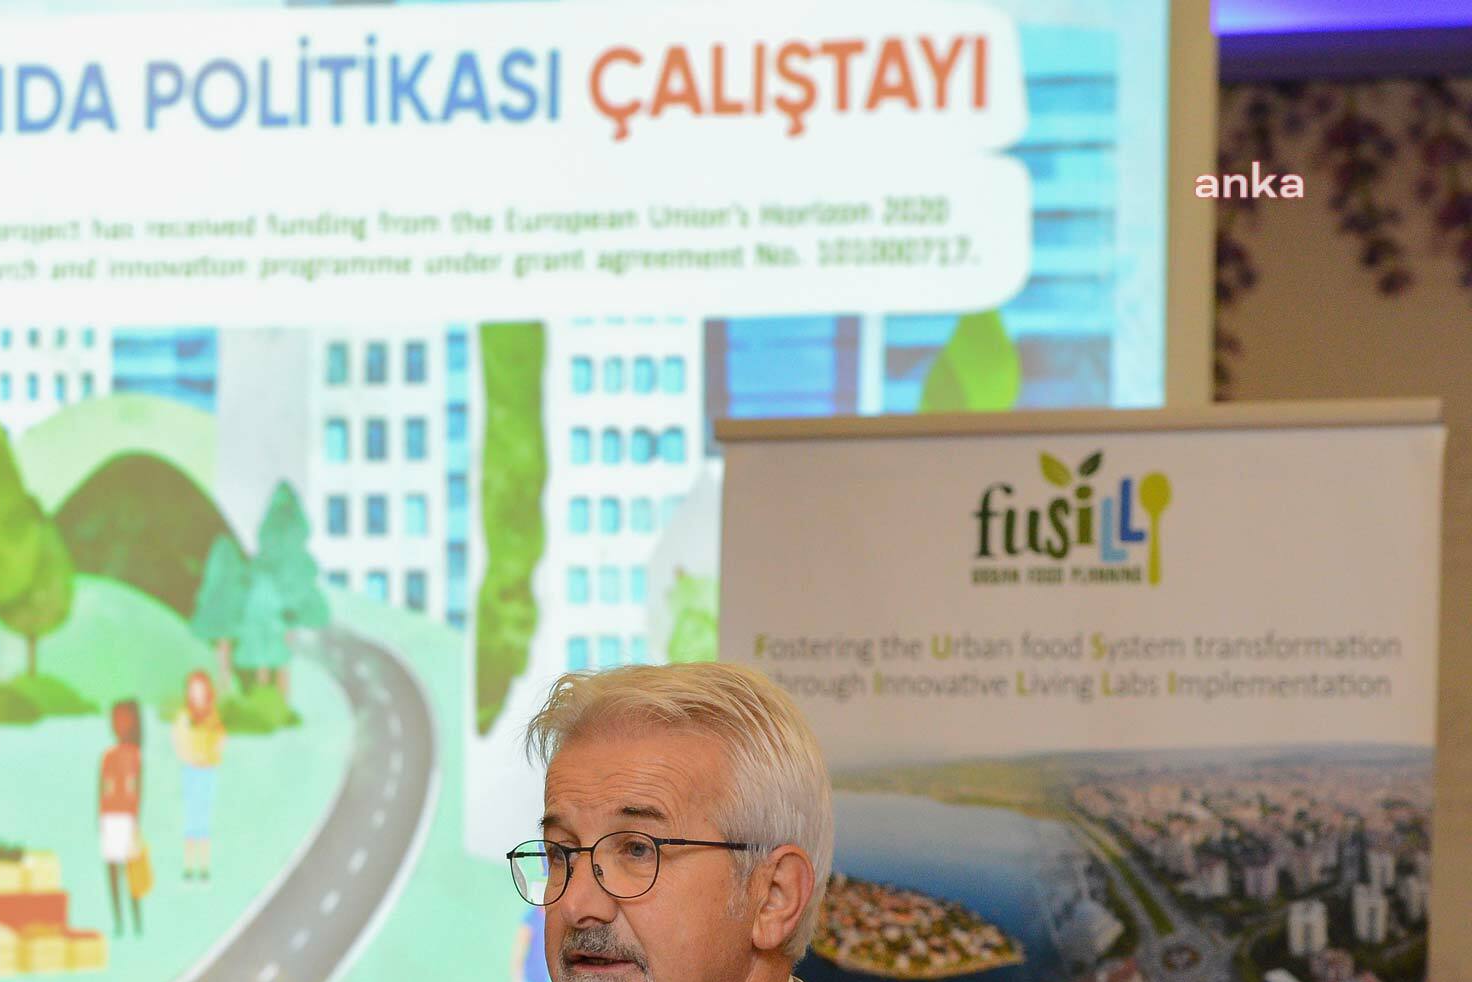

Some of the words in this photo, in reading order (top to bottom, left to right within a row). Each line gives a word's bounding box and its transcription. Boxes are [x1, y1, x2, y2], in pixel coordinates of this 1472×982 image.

[144, 34, 562, 132] POLİTİKASI
[590, 35, 990, 141] ÇALIŞTAYI
[91, 217, 134, 240] has
[144, 214, 256, 239] received
[267, 210, 368, 242] funding
[378, 209, 440, 234] from
[450, 209, 494, 234] the
[505, 205, 638, 234] European
[647, 202, 751, 230] Union's
[758, 201, 873, 227] Horizon
[881, 195, 952, 226] 2020
[50, 256, 97, 280] and
[108, 254, 246, 279] innovation
[257, 255, 413, 284] programme
[423, 250, 502, 275] under
[512, 248, 585, 280] grant
[596, 244, 745, 277] agreement
[754, 632, 874, 666] Fostering
[880, 633, 924, 659] the
[931, 631, 1014, 659] Urban
[1021, 630, 1083, 659] food
[1091, 632, 1186, 664] System
[1194, 630, 1403, 660] transformation
[771, 672, 866, 702] hrough
[874, 671, 1009, 697] Innovative
[1015, 671, 1094, 702] Living
[1101, 671, 1160, 697] Labs
[1168, 671, 1393, 702] Implementation
